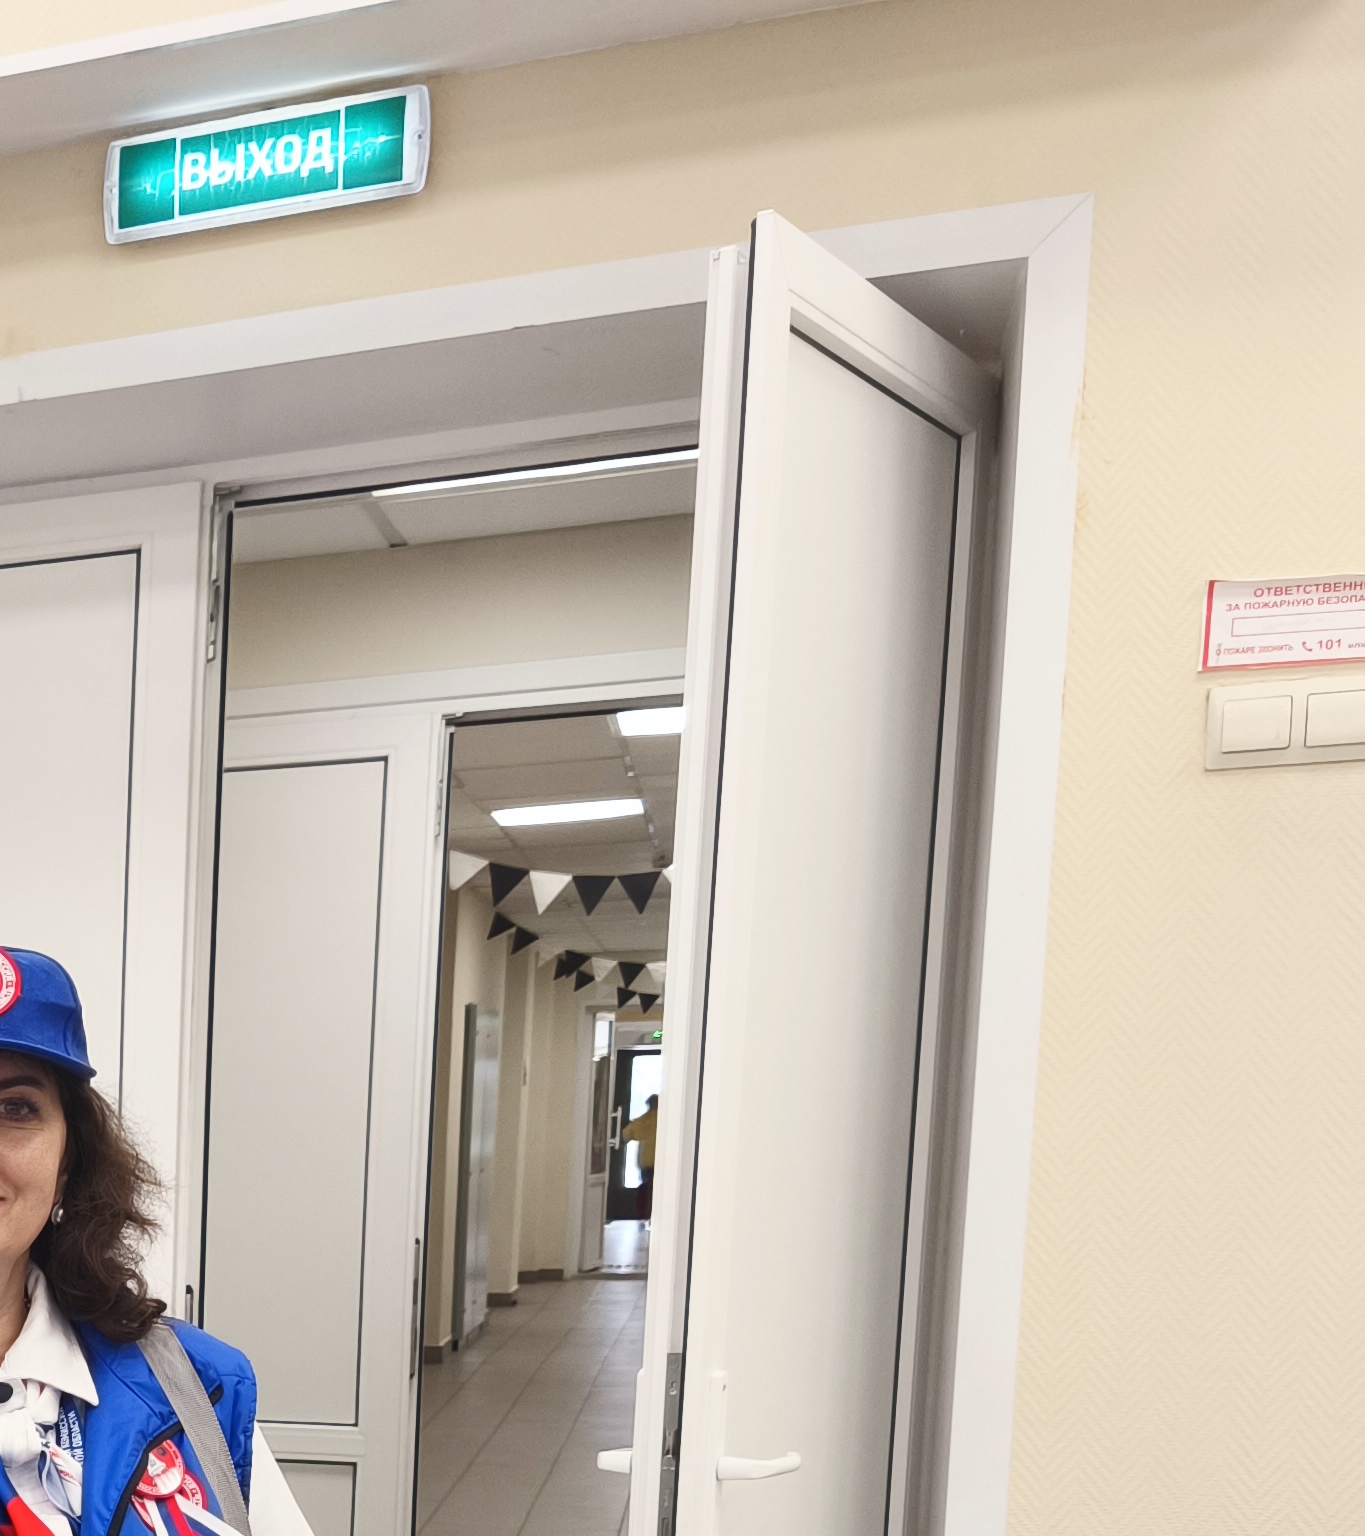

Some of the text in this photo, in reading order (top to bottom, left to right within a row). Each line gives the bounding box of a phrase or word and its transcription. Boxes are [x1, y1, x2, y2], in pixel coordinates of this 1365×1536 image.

[181, 127, 333, 191] ВЫХОД
[1254, 581, 1365, 598] ОТВЕТСТВЕНН
[1226, 603, 1240, 611] ЗА
[1244, 598, 1313, 609] ПОЖАРНУЮ
[1224, 647, 1255, 655] ПОЖАРЕ
[1317, 639, 1342, 650] 101
